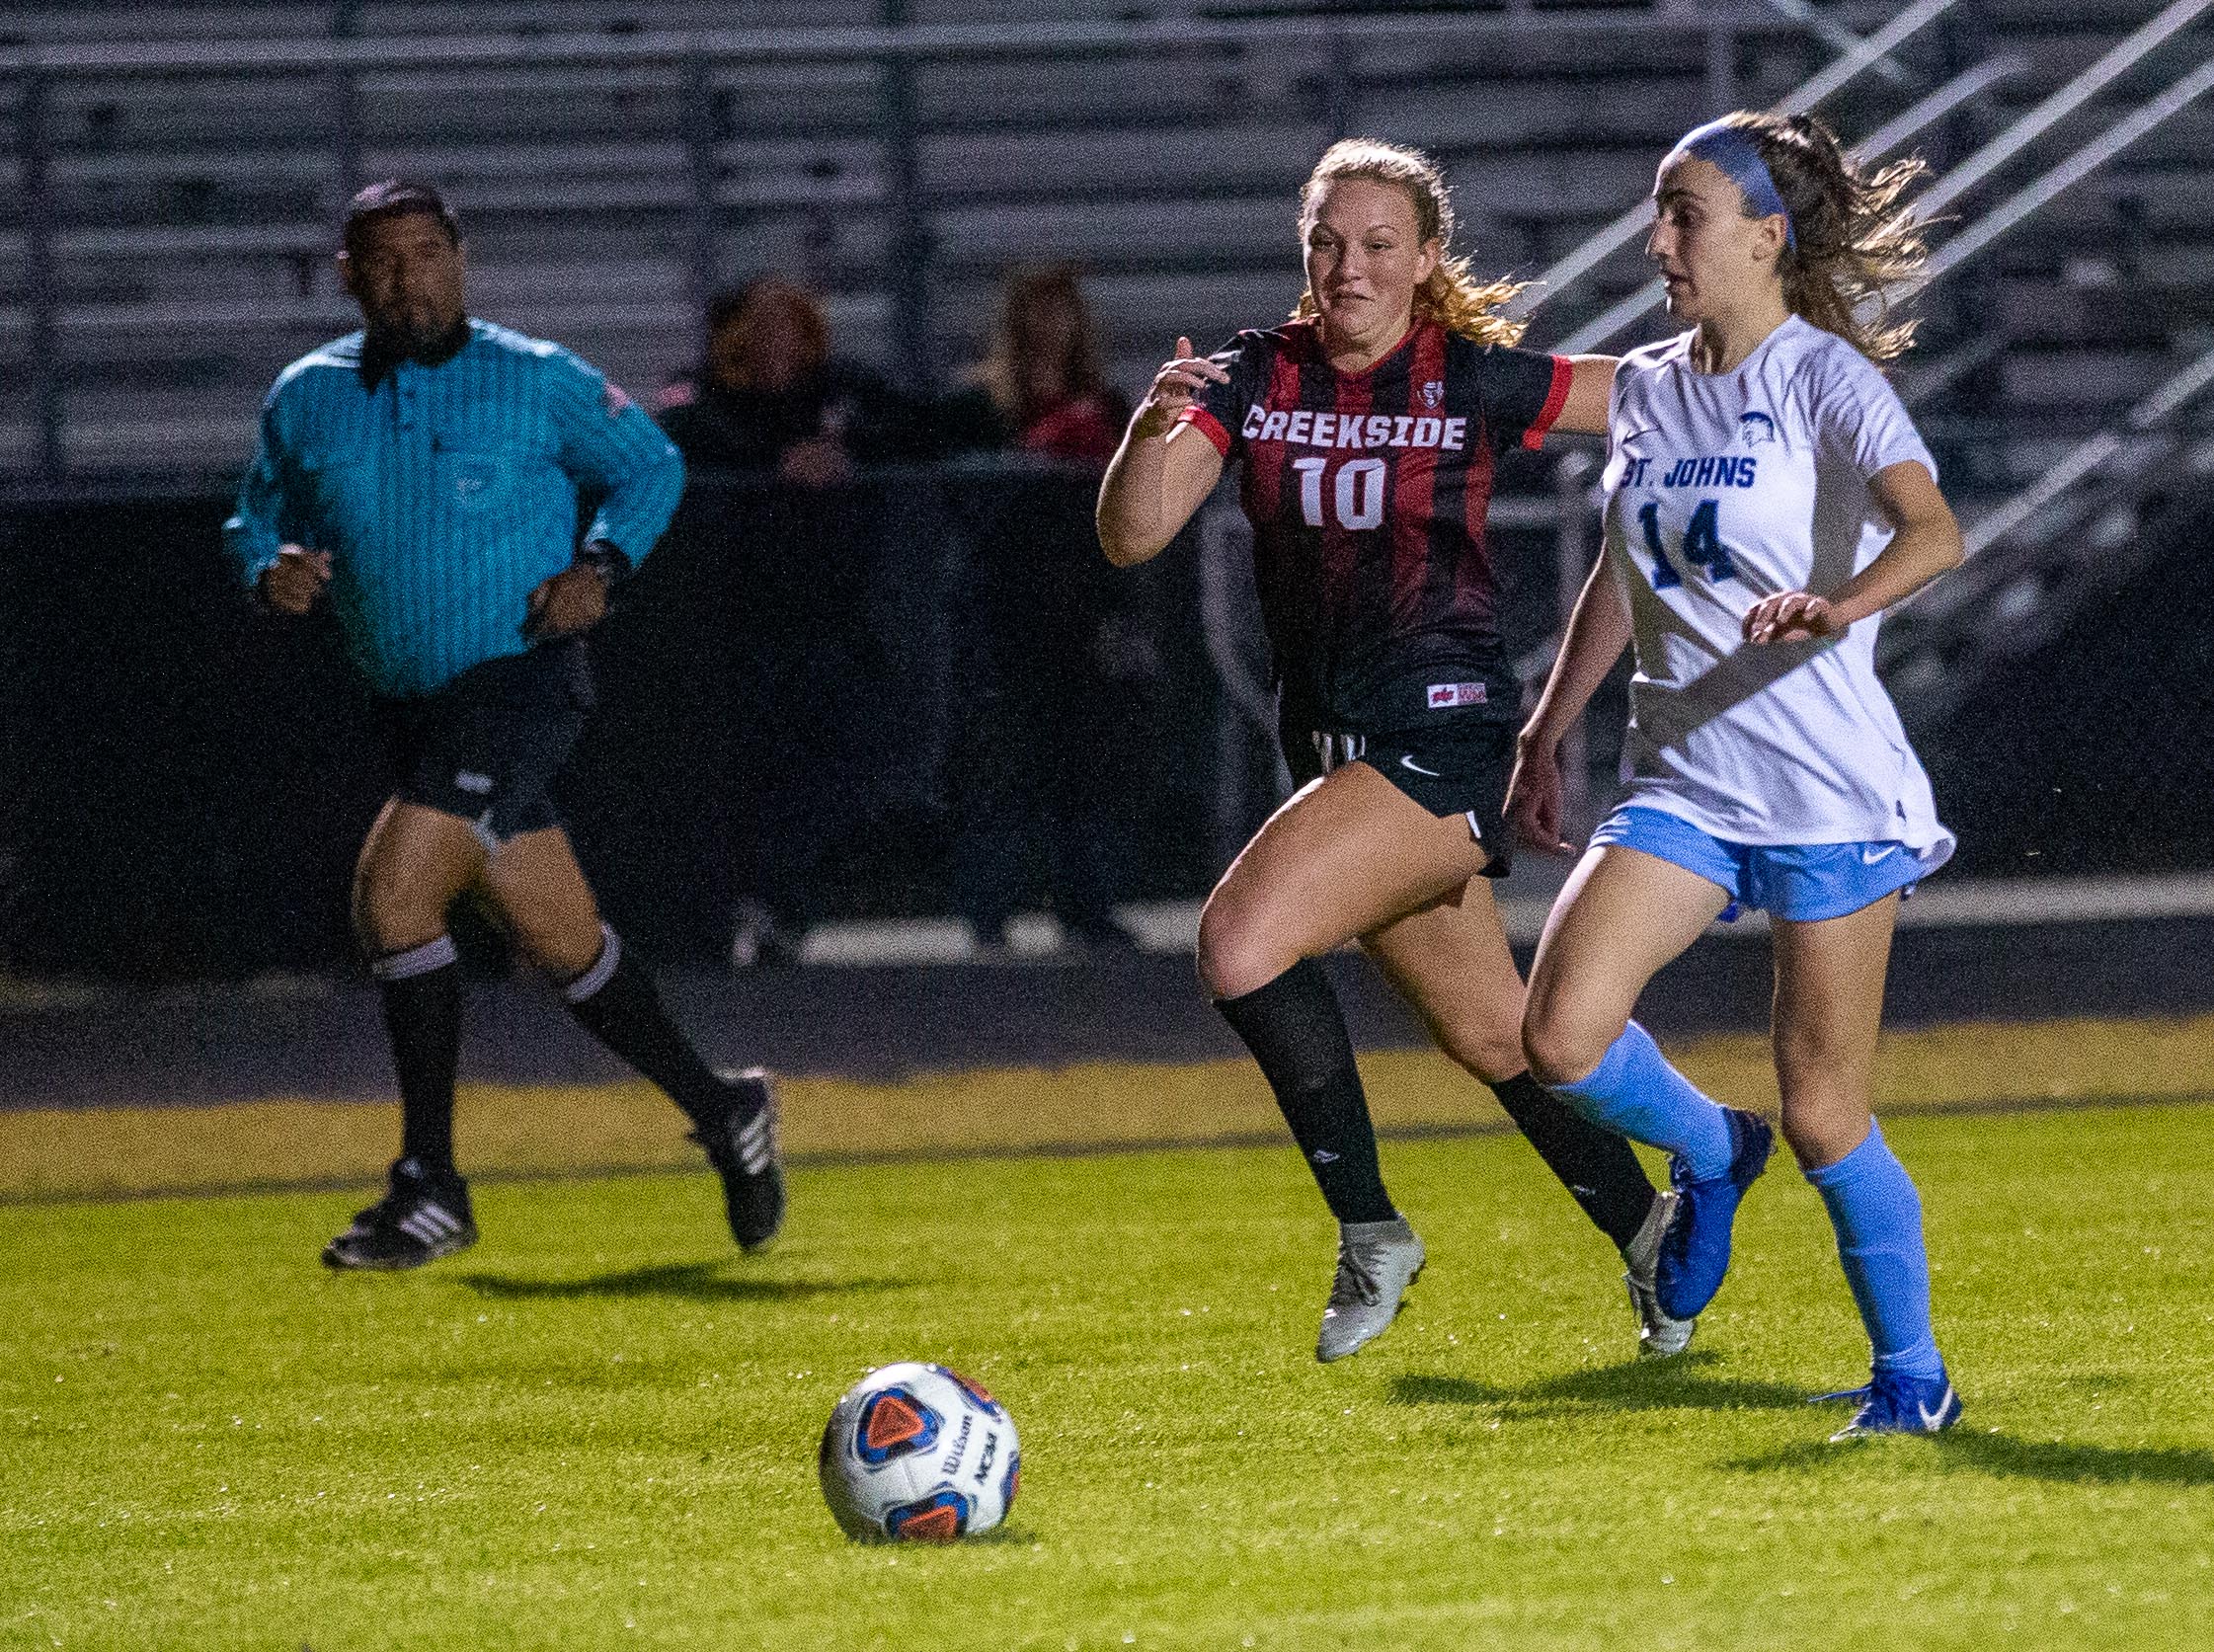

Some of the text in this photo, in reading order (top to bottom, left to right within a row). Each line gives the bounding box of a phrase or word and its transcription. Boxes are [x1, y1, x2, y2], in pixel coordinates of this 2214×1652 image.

[1241, 405, 1467, 451] CREEKSIDE
[1292, 456, 1386, 530] 10
[1663, 456, 1758, 489] JOHNS
[1637, 499, 1736, 590] 14
[941, 1413, 974, 1476] Wilson
